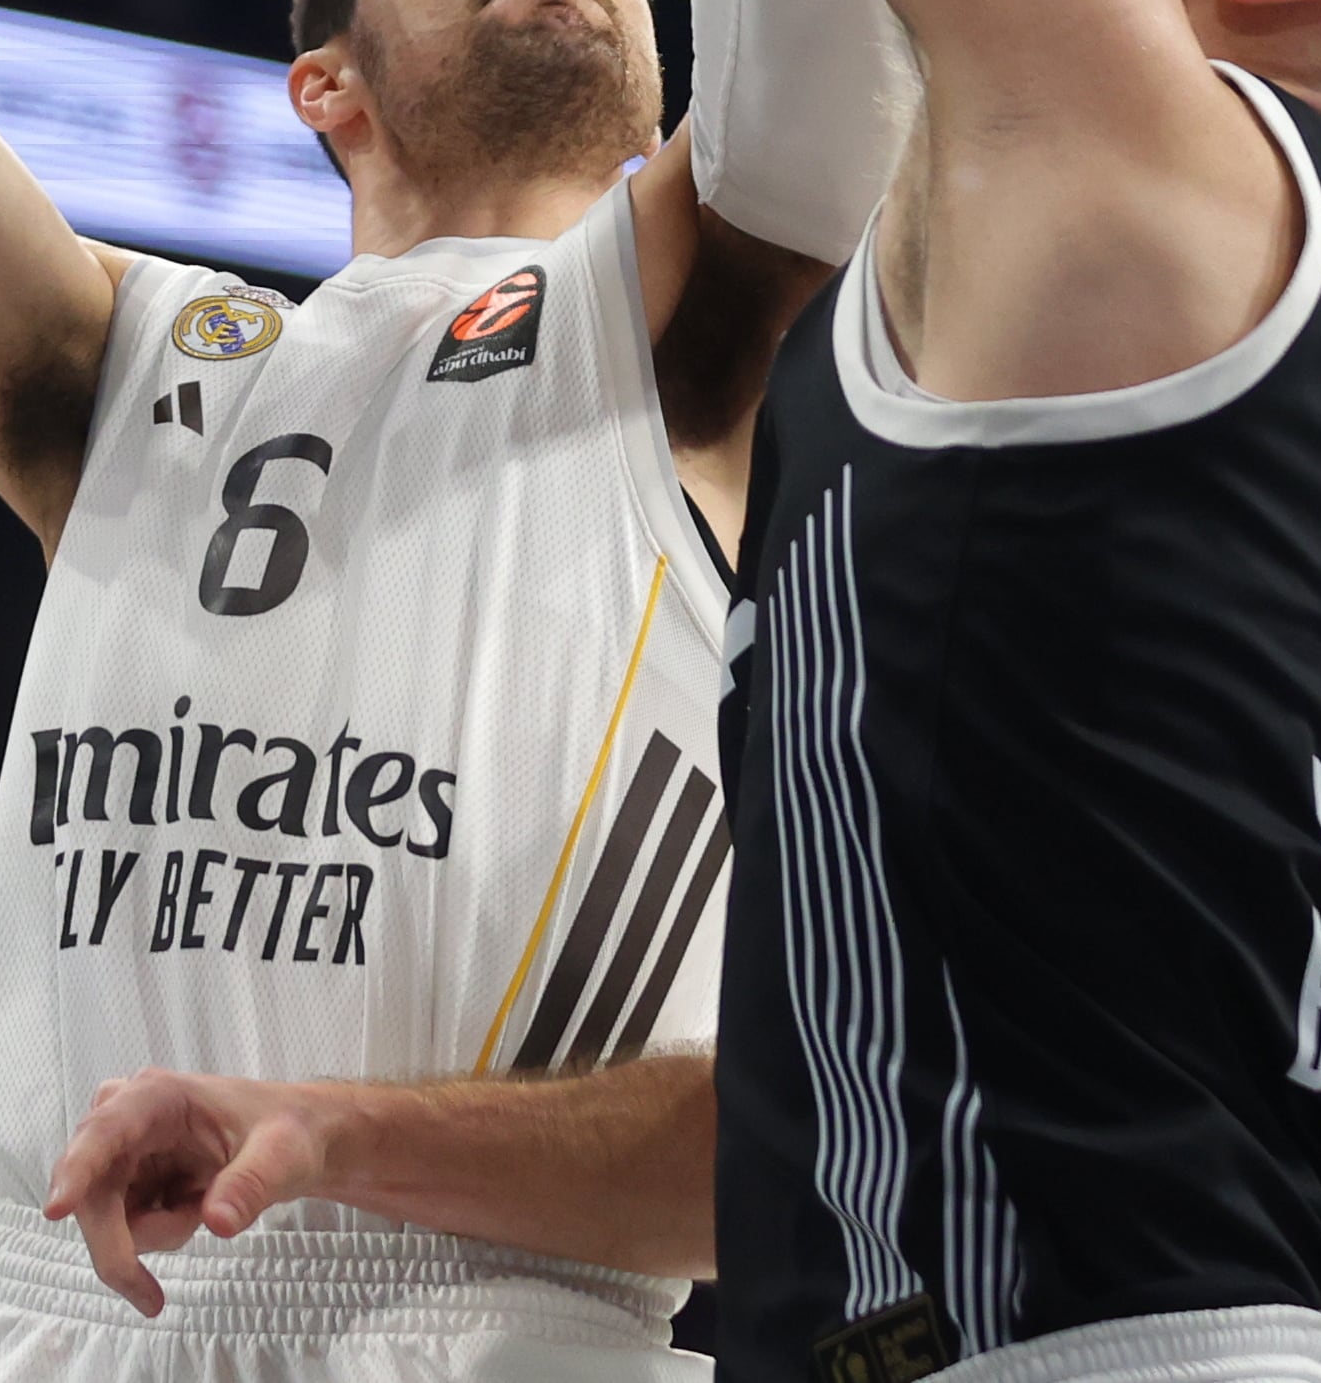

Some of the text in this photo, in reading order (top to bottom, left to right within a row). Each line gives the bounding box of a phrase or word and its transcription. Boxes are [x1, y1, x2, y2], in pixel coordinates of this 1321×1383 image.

[469, 346, 527, 366] dhabi
[199, 433, 333, 616] 6
[55, 849, 374, 966] LY BETTER
